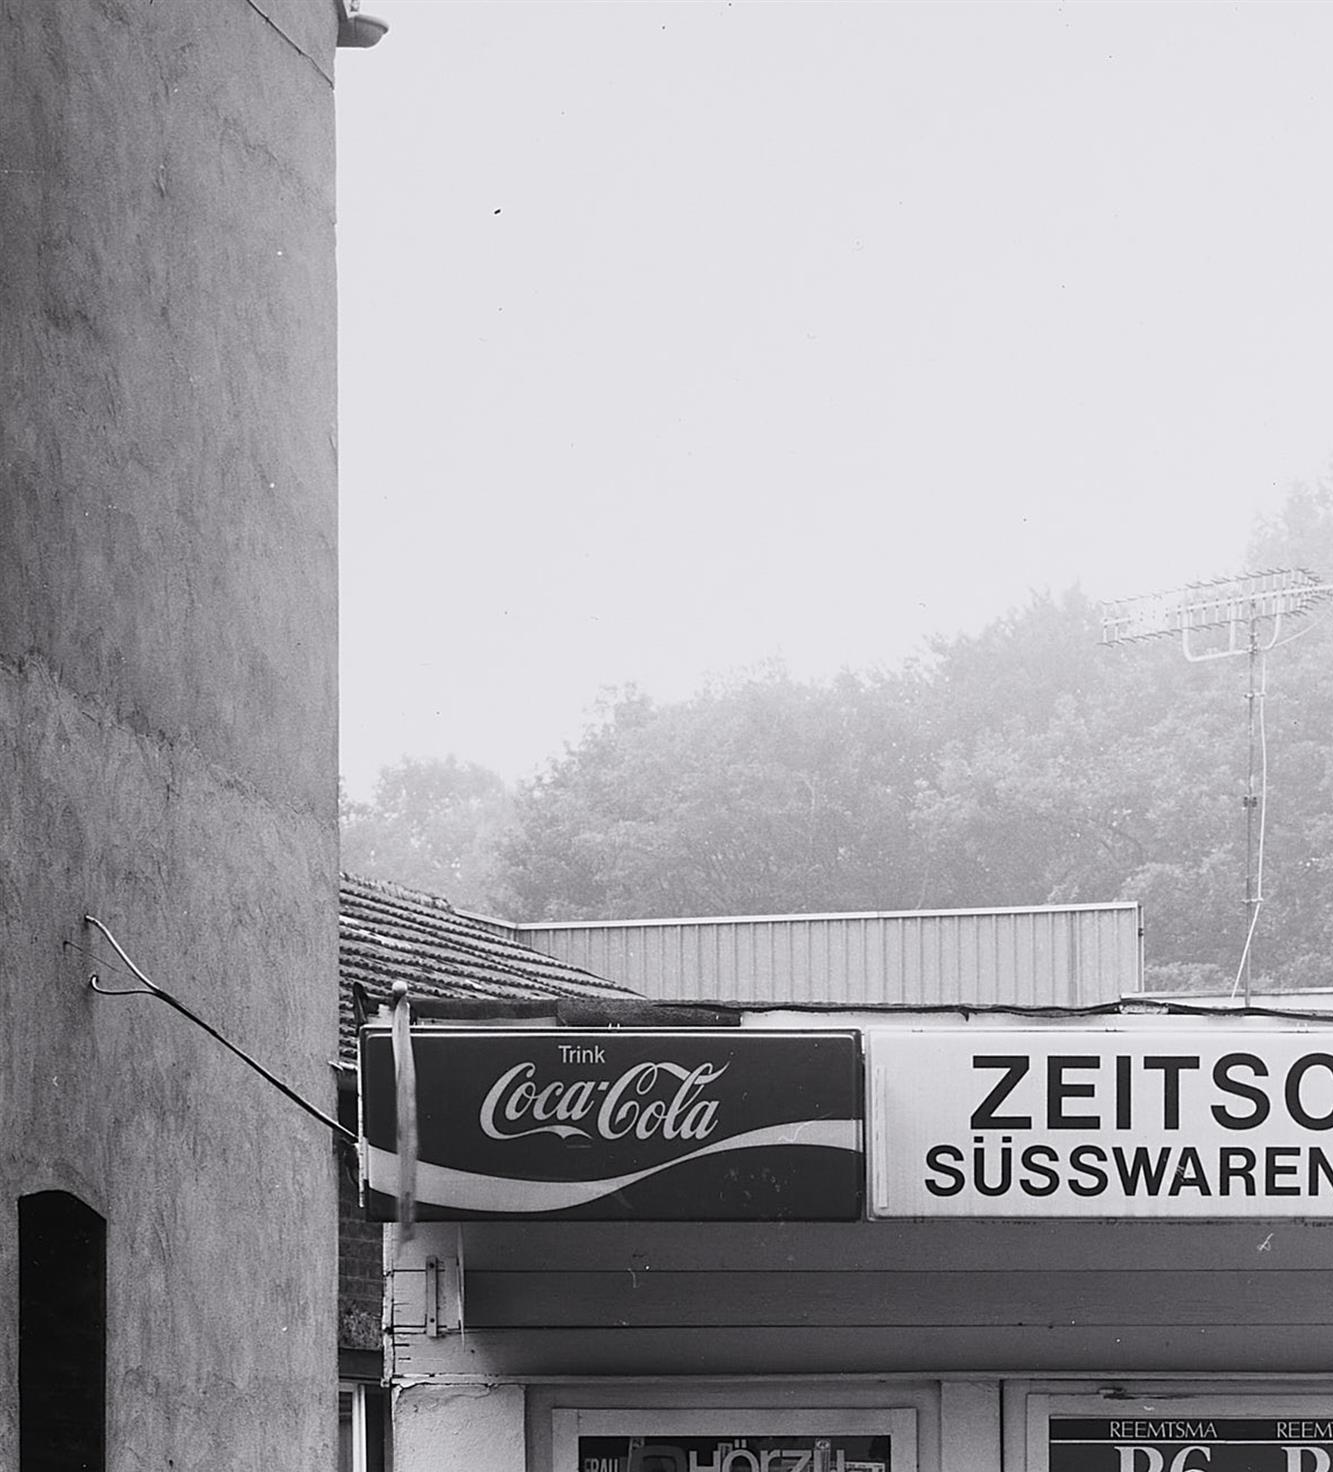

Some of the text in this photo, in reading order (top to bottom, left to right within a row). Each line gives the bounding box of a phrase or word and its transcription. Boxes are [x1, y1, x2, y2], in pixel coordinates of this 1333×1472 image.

[558, 1046, 606, 1066] Trink
[480, 1061, 730, 1143] Coca-Cola
[1109, 1421, 1218, 1440] REEMTSMA
